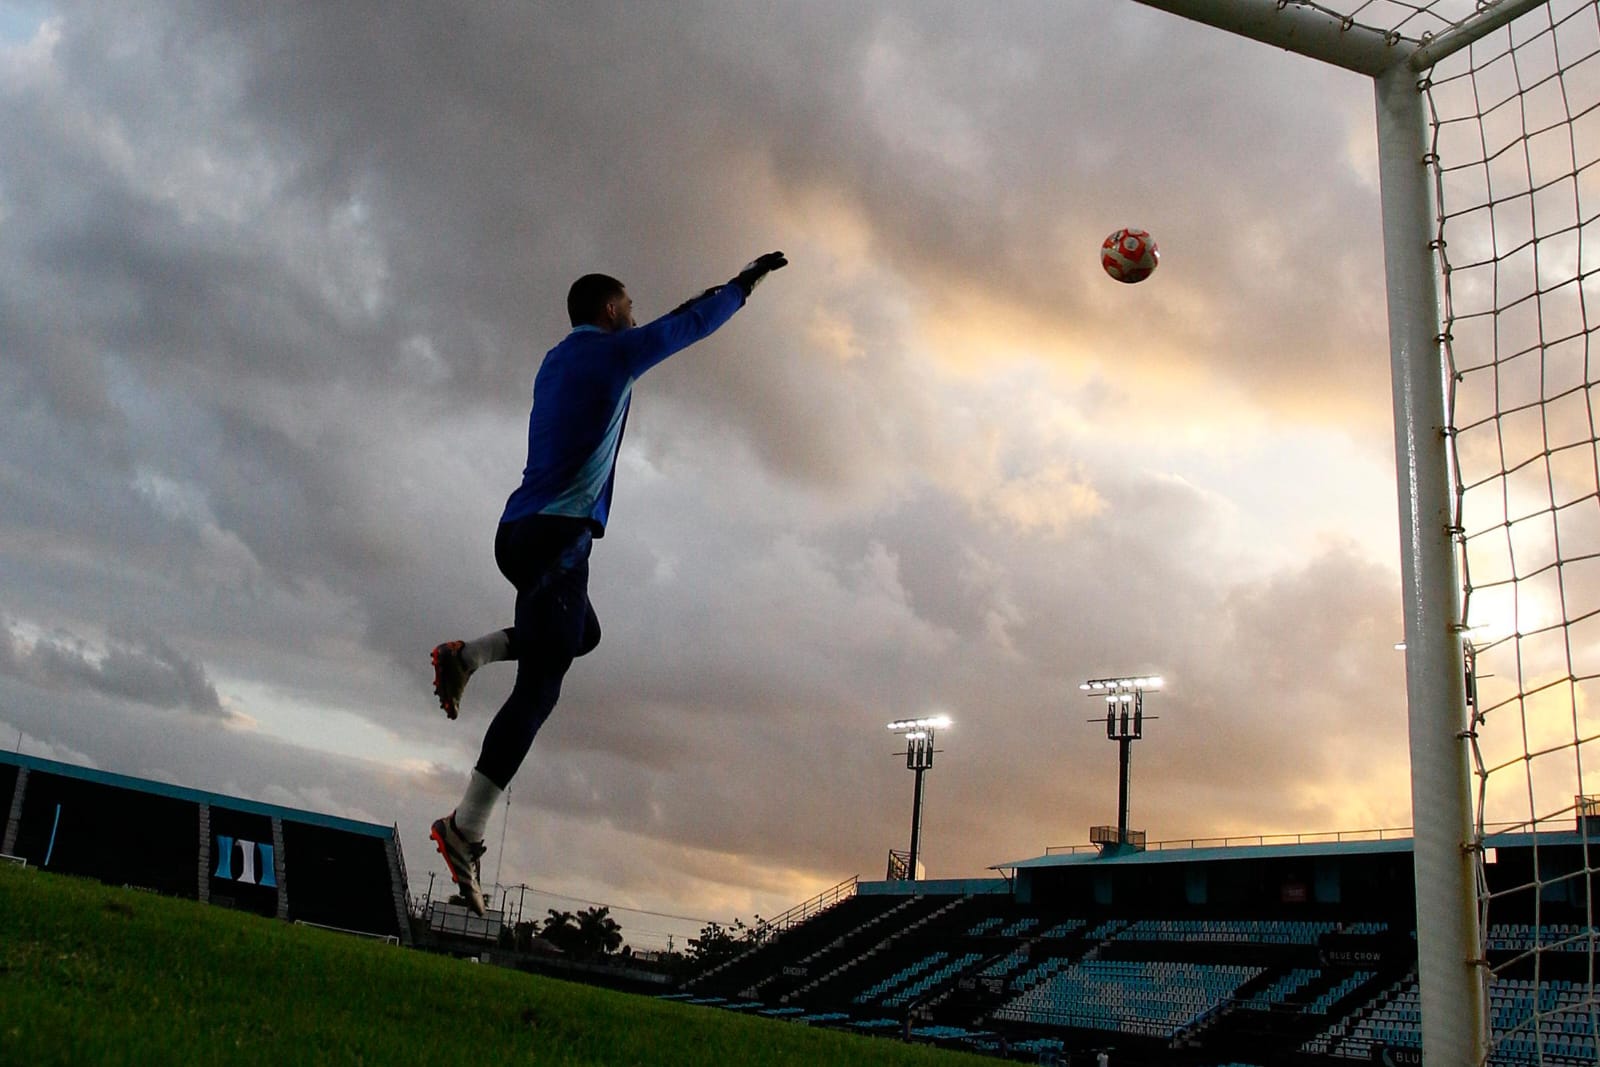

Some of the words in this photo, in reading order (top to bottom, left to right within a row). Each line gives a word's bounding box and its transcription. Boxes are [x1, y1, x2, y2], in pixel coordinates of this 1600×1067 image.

[1329, 951, 1352, 960] BLUE
[1353, 951, 1381, 961] CROW
[1395, 1051, 1420, 1064] BLU
